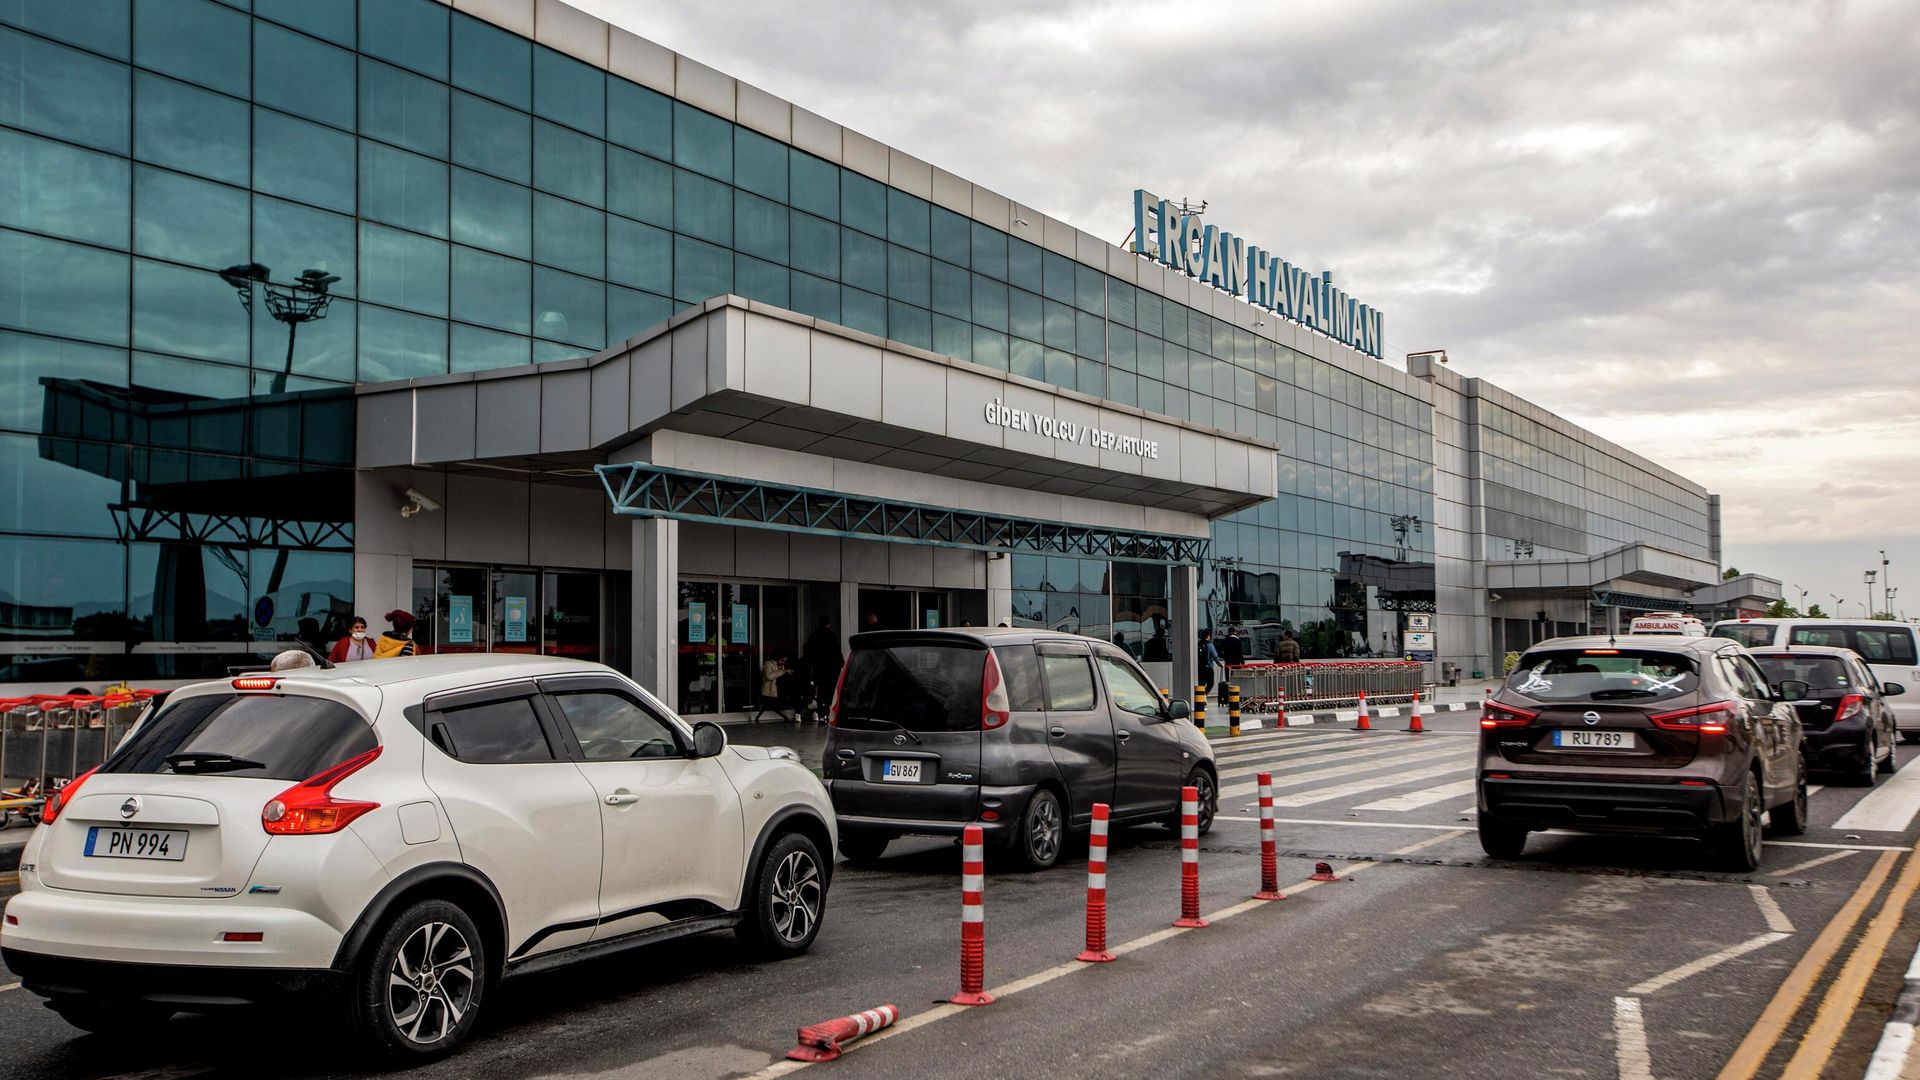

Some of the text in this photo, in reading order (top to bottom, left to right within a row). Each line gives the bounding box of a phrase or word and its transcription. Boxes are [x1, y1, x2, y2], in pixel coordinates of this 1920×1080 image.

[1134, 189, 1244, 296] ERCAN
[985, 397, 1158, 459] GİDEN YOLCU / DEPARTURE
[1634, 622, 1679, 630] AMBULANS
[1572, 732, 1621, 746] RU 789
[891, 765, 919, 777] GV 867
[109, 831, 171, 856] PN 994
